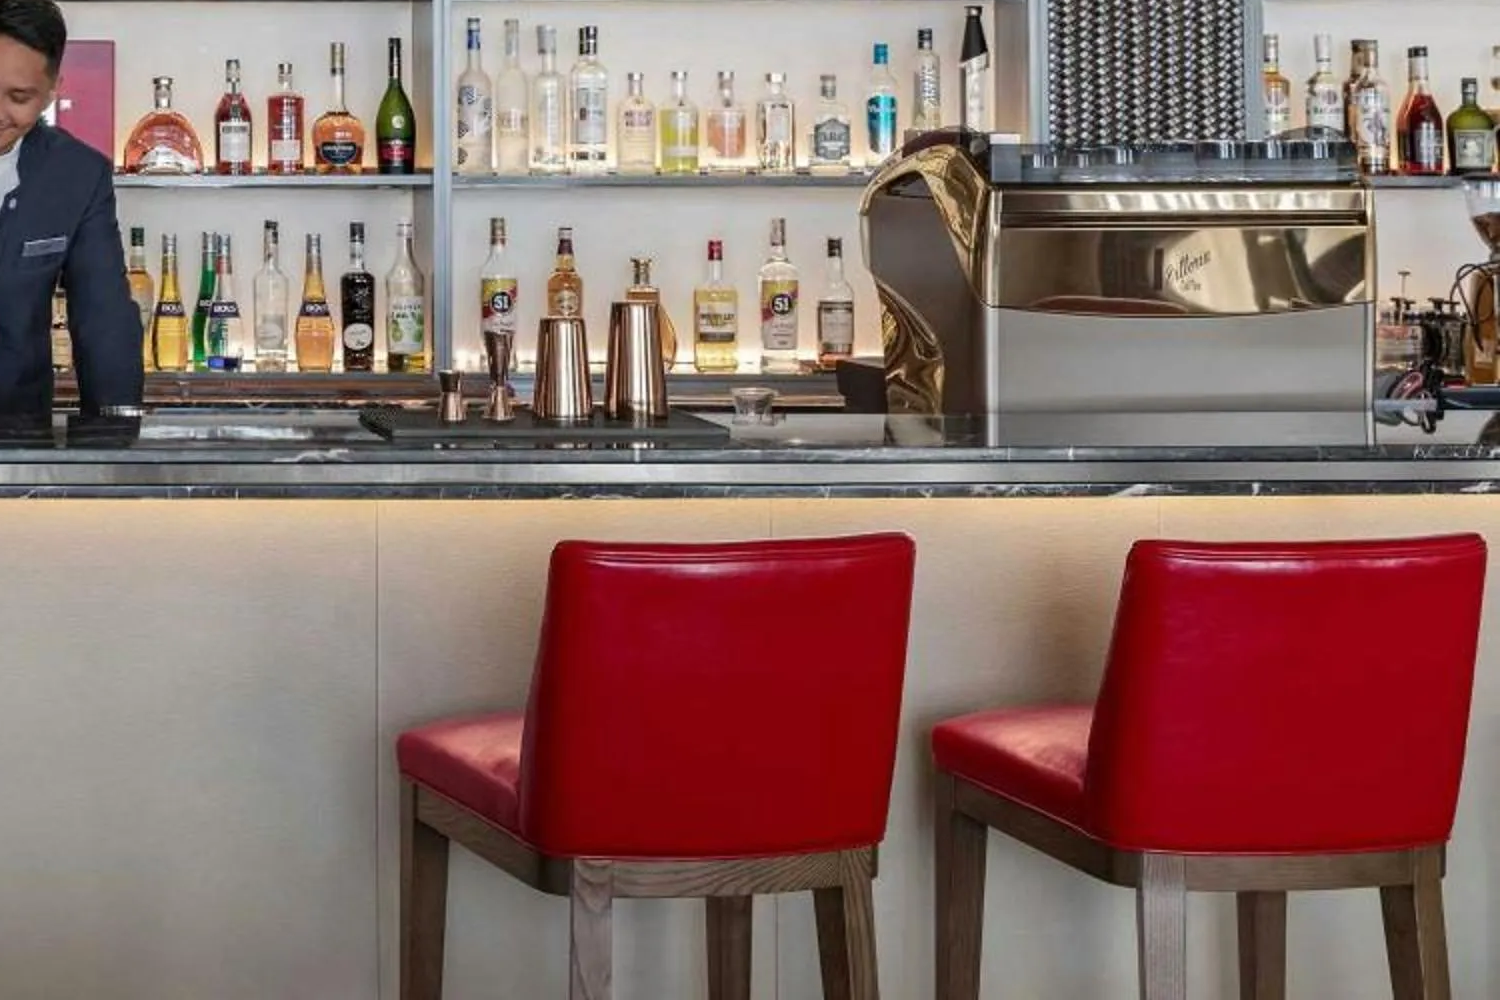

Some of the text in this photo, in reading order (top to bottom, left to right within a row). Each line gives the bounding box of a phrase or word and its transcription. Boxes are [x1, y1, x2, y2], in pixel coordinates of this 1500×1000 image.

[493, 294, 510, 310] 51
[773, 298, 790, 311] 51
[161, 304, 183, 313] BOLS
[213, 304, 237, 313] BOLS
